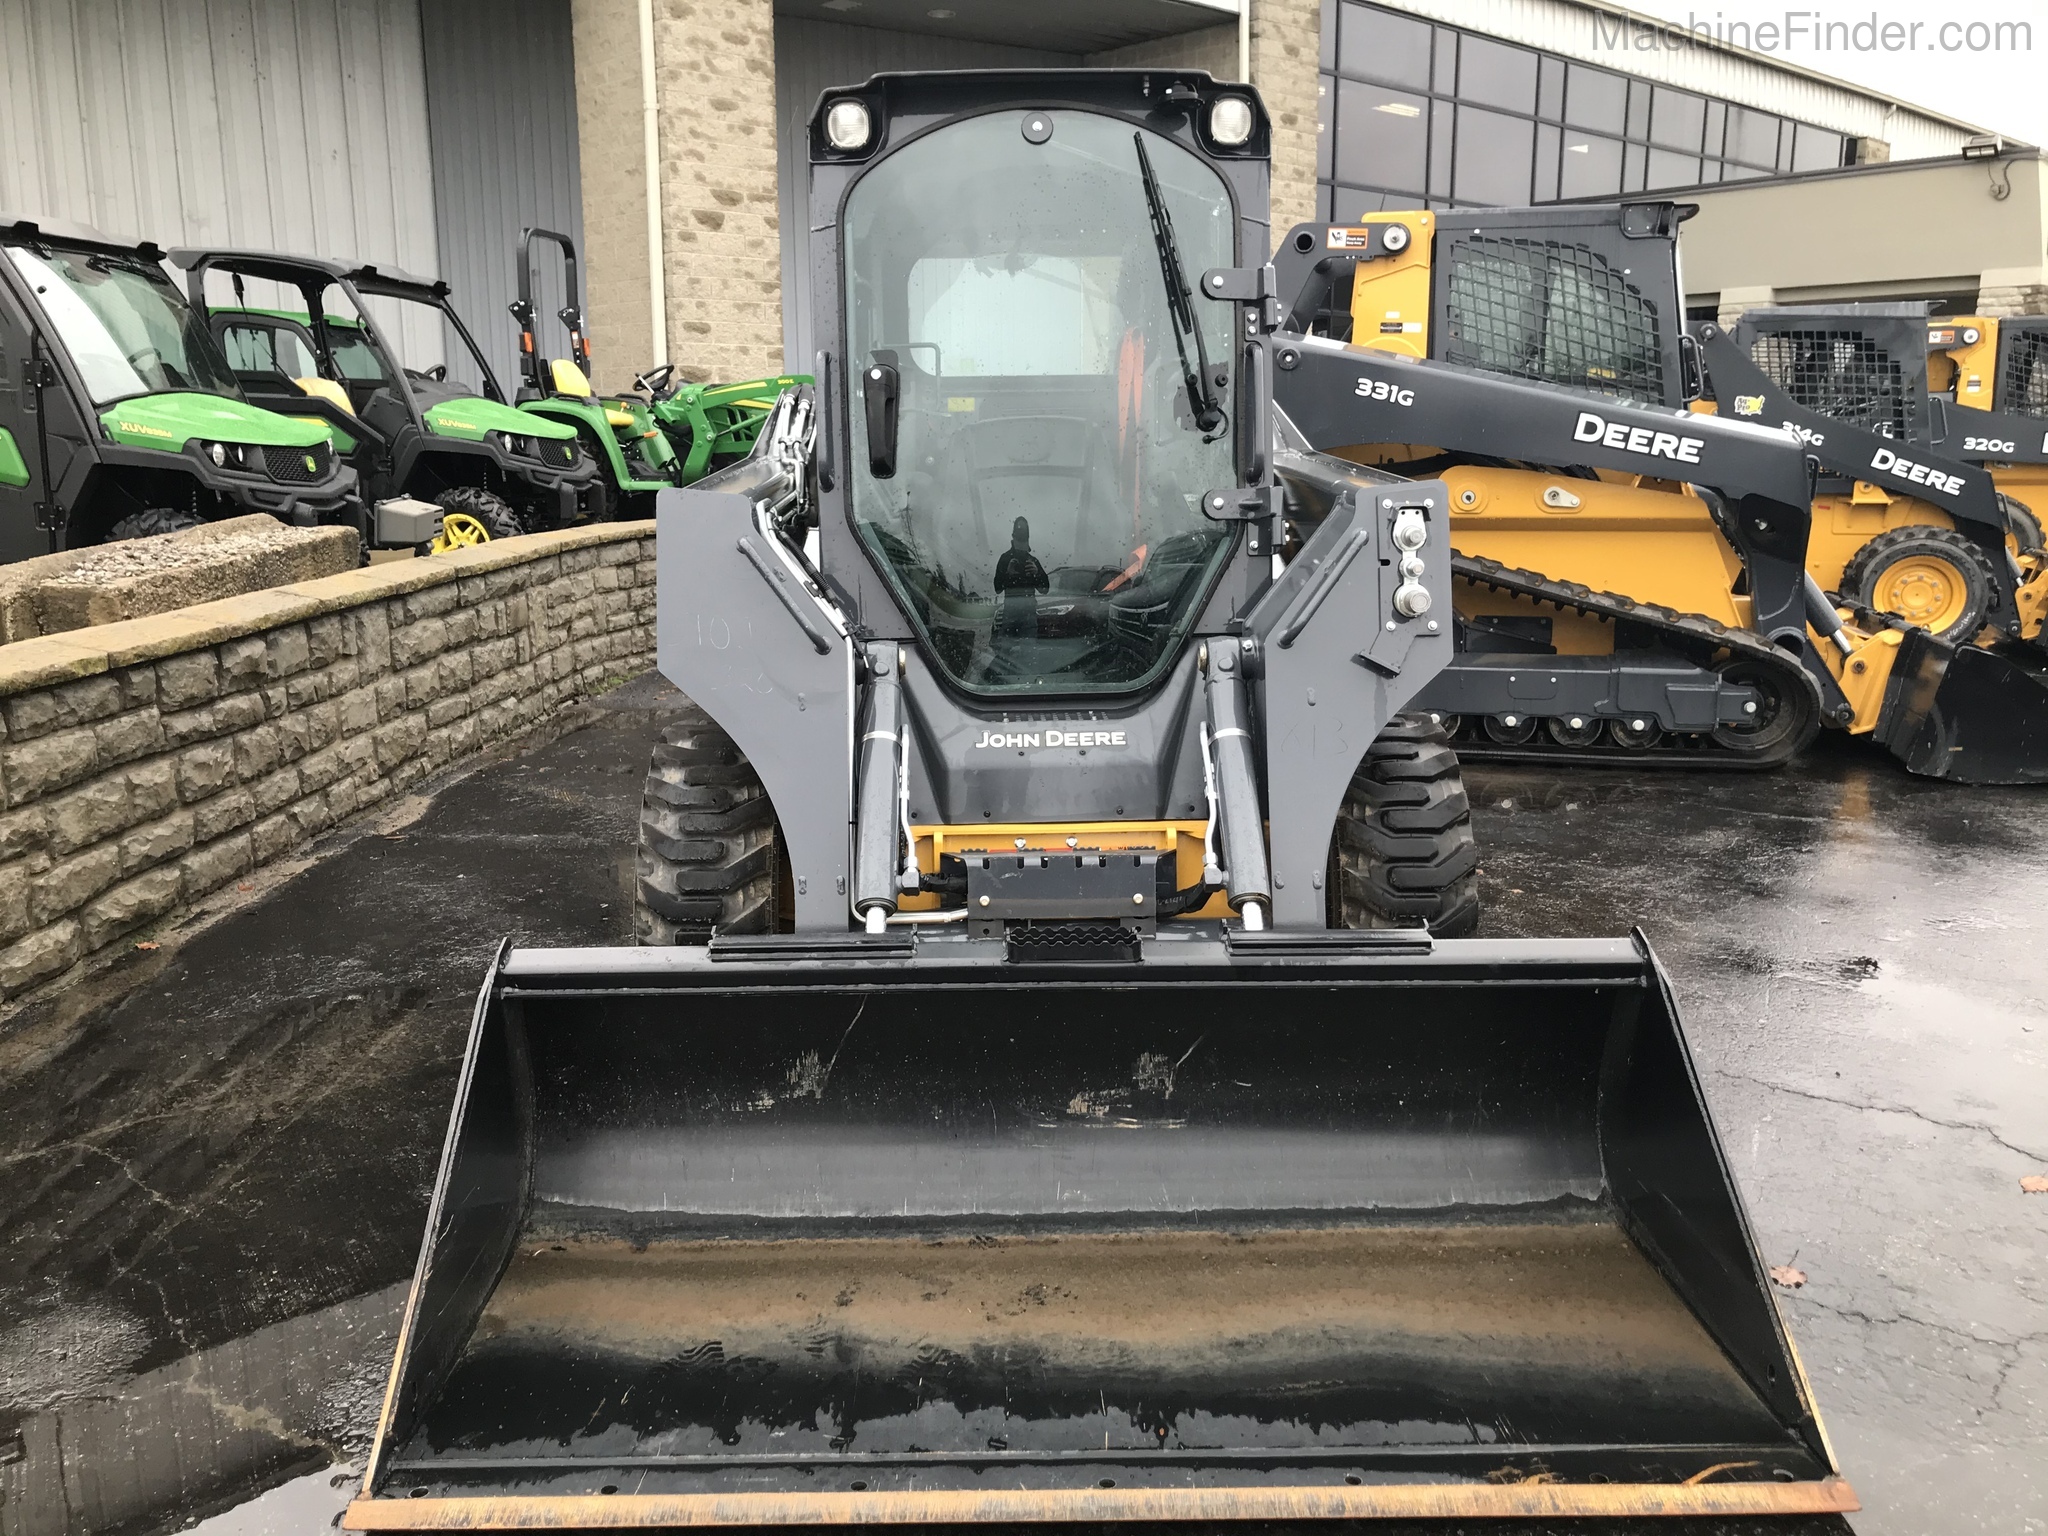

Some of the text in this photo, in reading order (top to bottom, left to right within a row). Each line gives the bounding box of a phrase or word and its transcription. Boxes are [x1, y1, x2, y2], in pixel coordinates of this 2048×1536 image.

[1353, 377, 1415, 407] 331G
[1573, 412, 1705, 464] DEERE
[1963, 436, 2015, 453] 320G
[1870, 447, 1966, 496] DEERE
[975, 730, 1127, 749] JOHN DEERE
